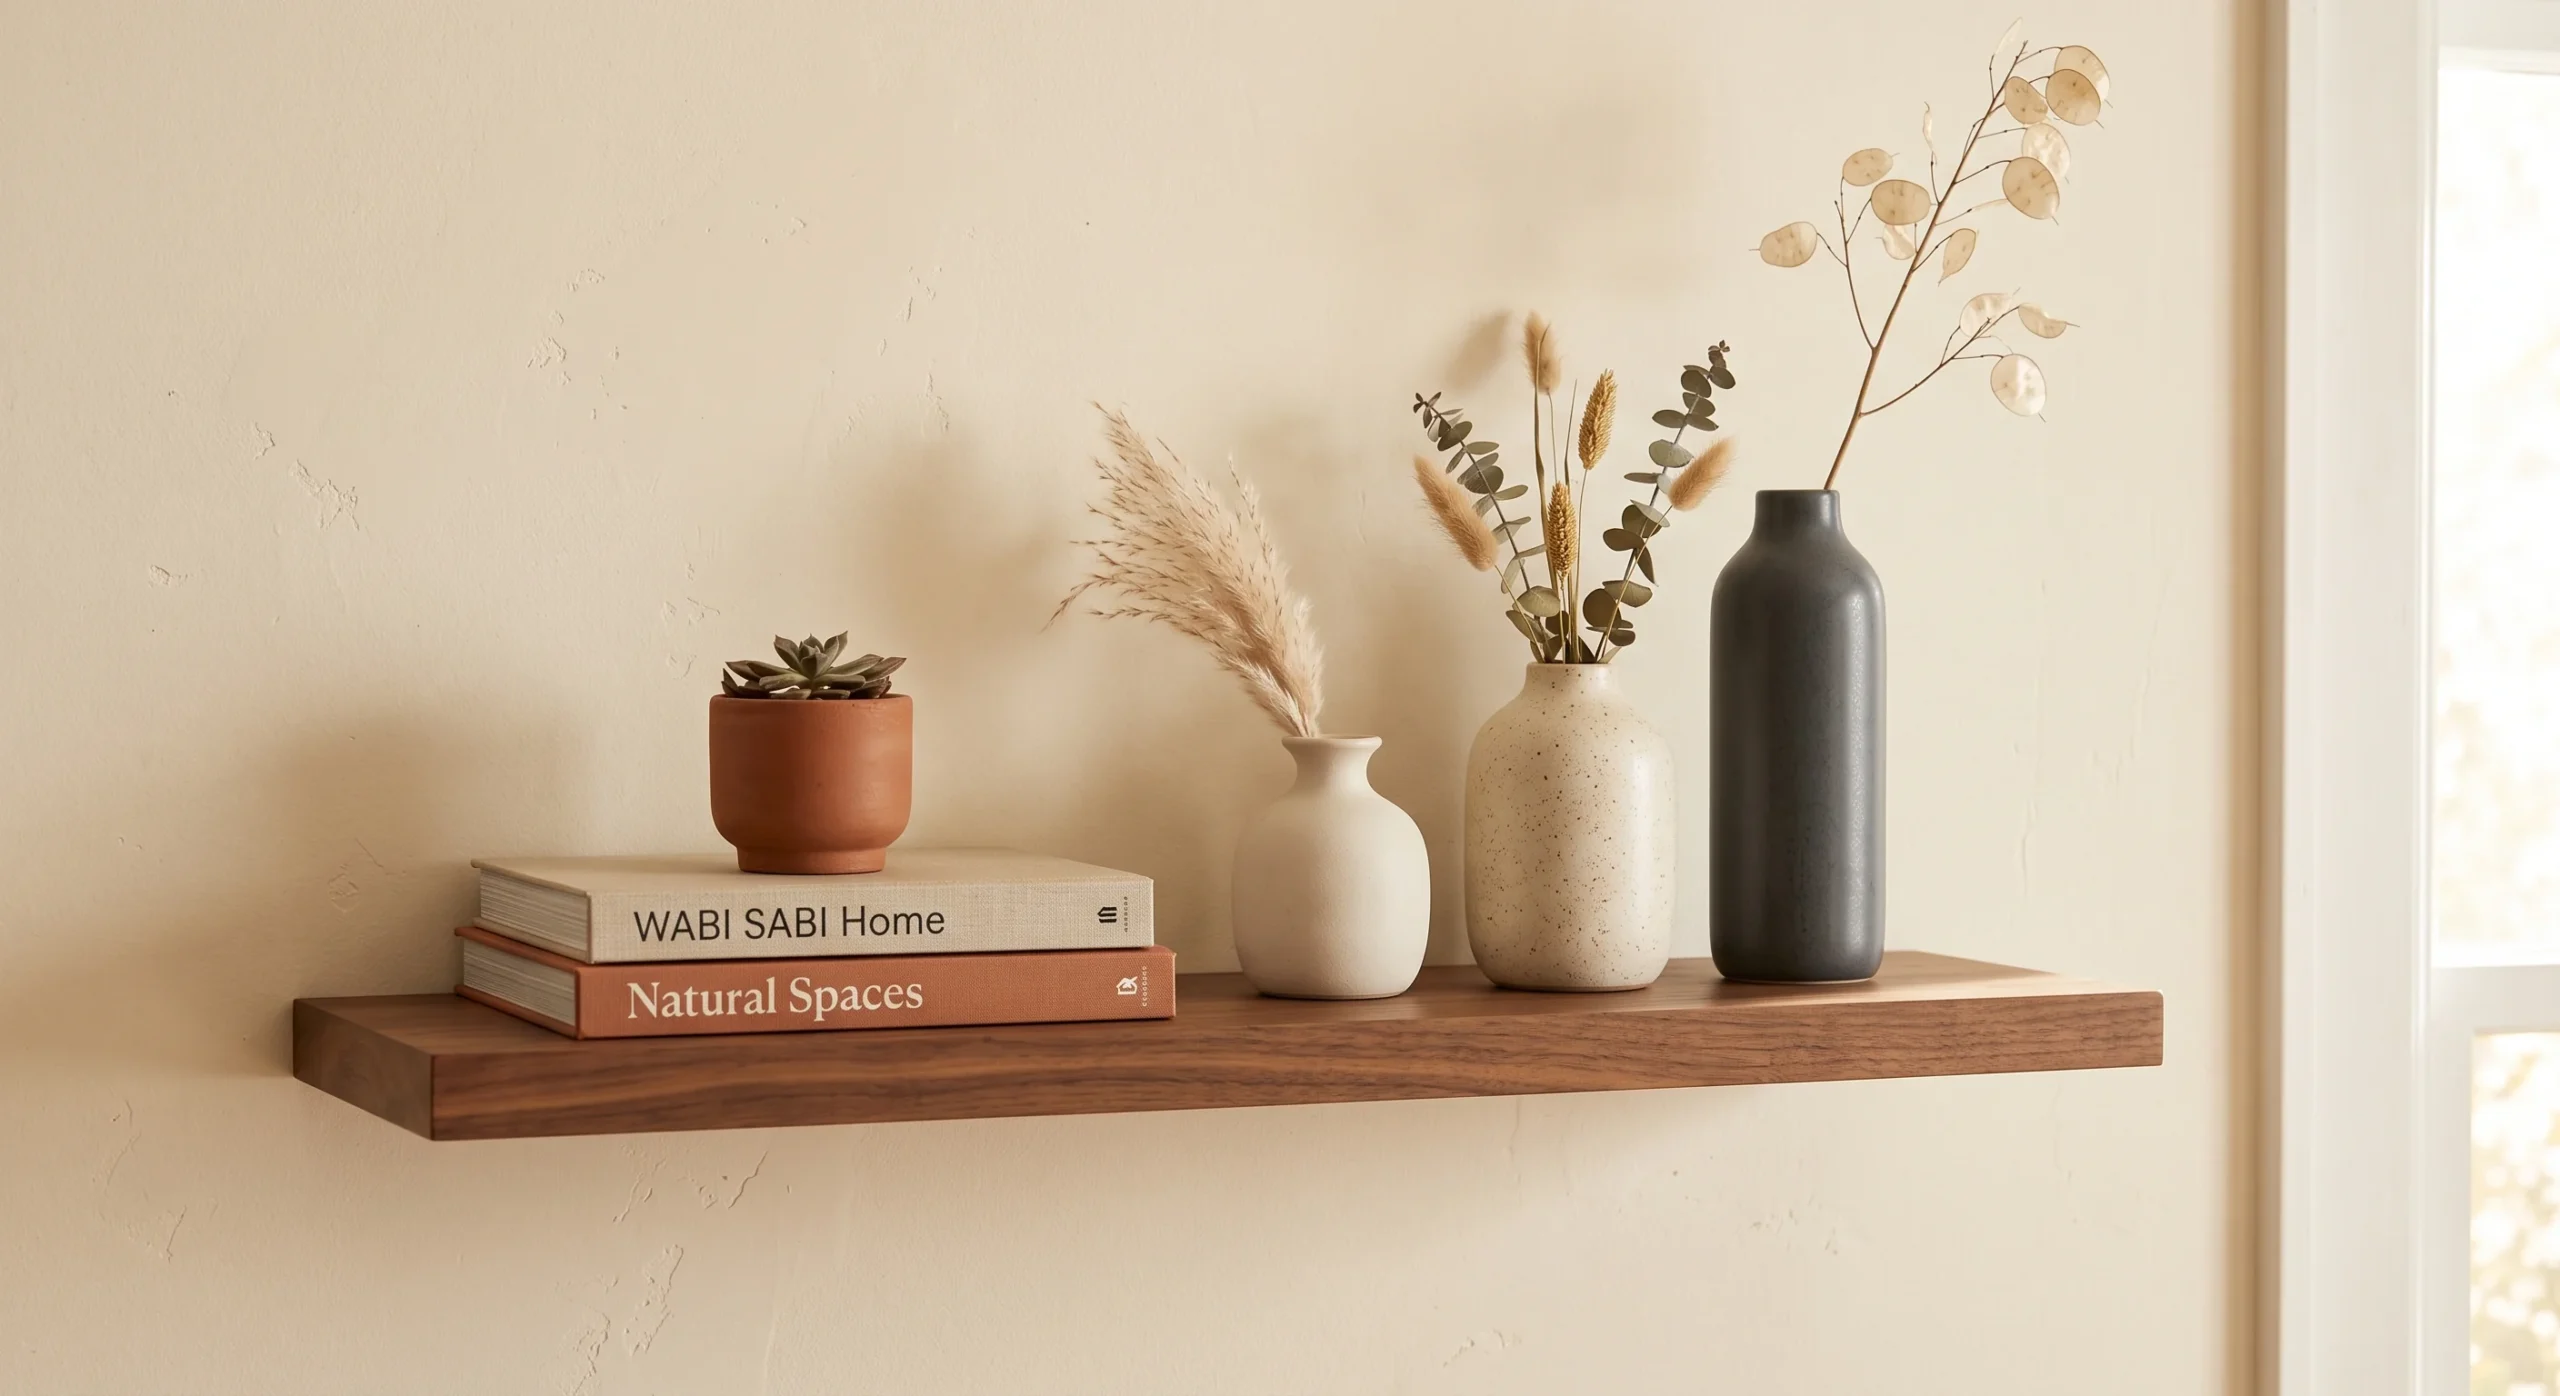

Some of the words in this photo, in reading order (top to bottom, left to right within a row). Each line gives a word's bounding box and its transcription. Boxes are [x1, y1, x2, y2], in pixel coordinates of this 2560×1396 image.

[634, 908, 730, 943] WABI
[744, 906, 828, 940] SABI
[842, 905, 946, 938] Home
[627, 976, 777, 1019] Natural
[789, 977, 924, 1022] Spaces
